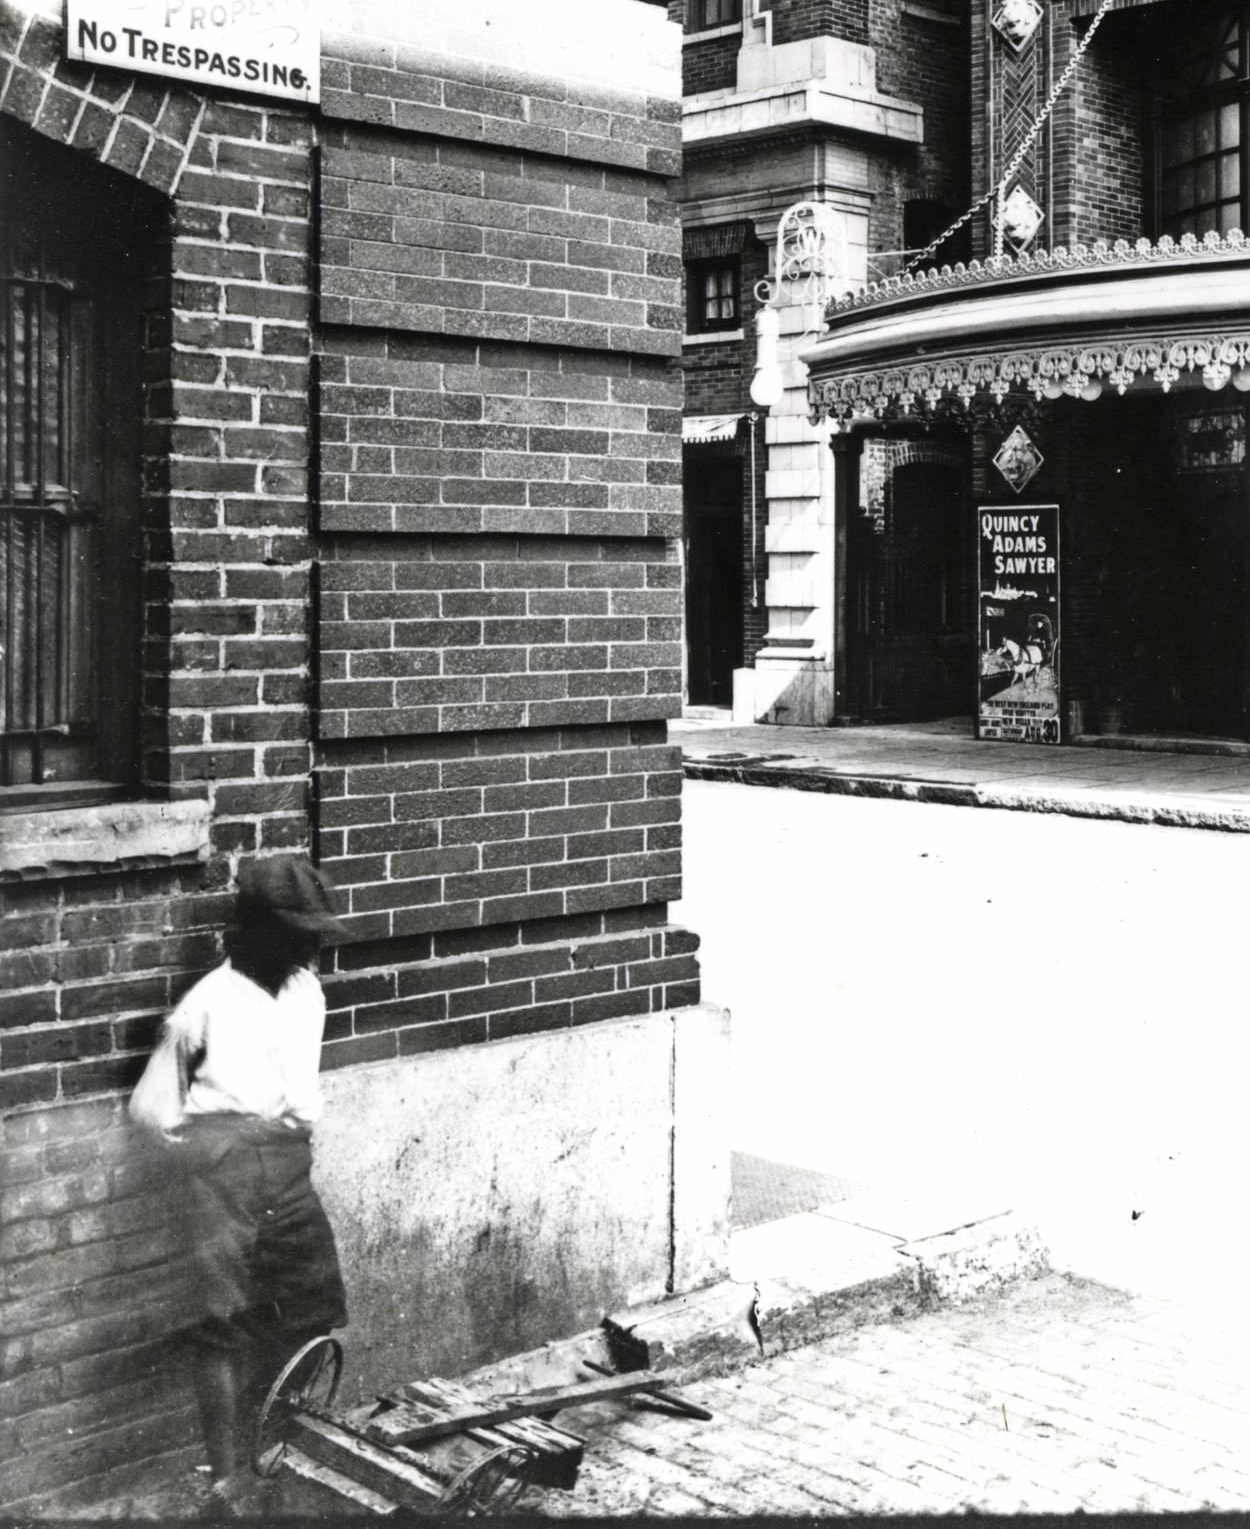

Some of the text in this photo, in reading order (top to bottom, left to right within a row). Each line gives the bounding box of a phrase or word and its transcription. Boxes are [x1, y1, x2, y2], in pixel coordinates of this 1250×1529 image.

[121, 27, 311, 91] TRESPASSING.
[981, 513, 1040, 540] QUINCY
[992, 534, 1047, 553] ADAMS
[994, 555, 1056, 574] SAWYER
[1043, 719, 1059, 742] 30
